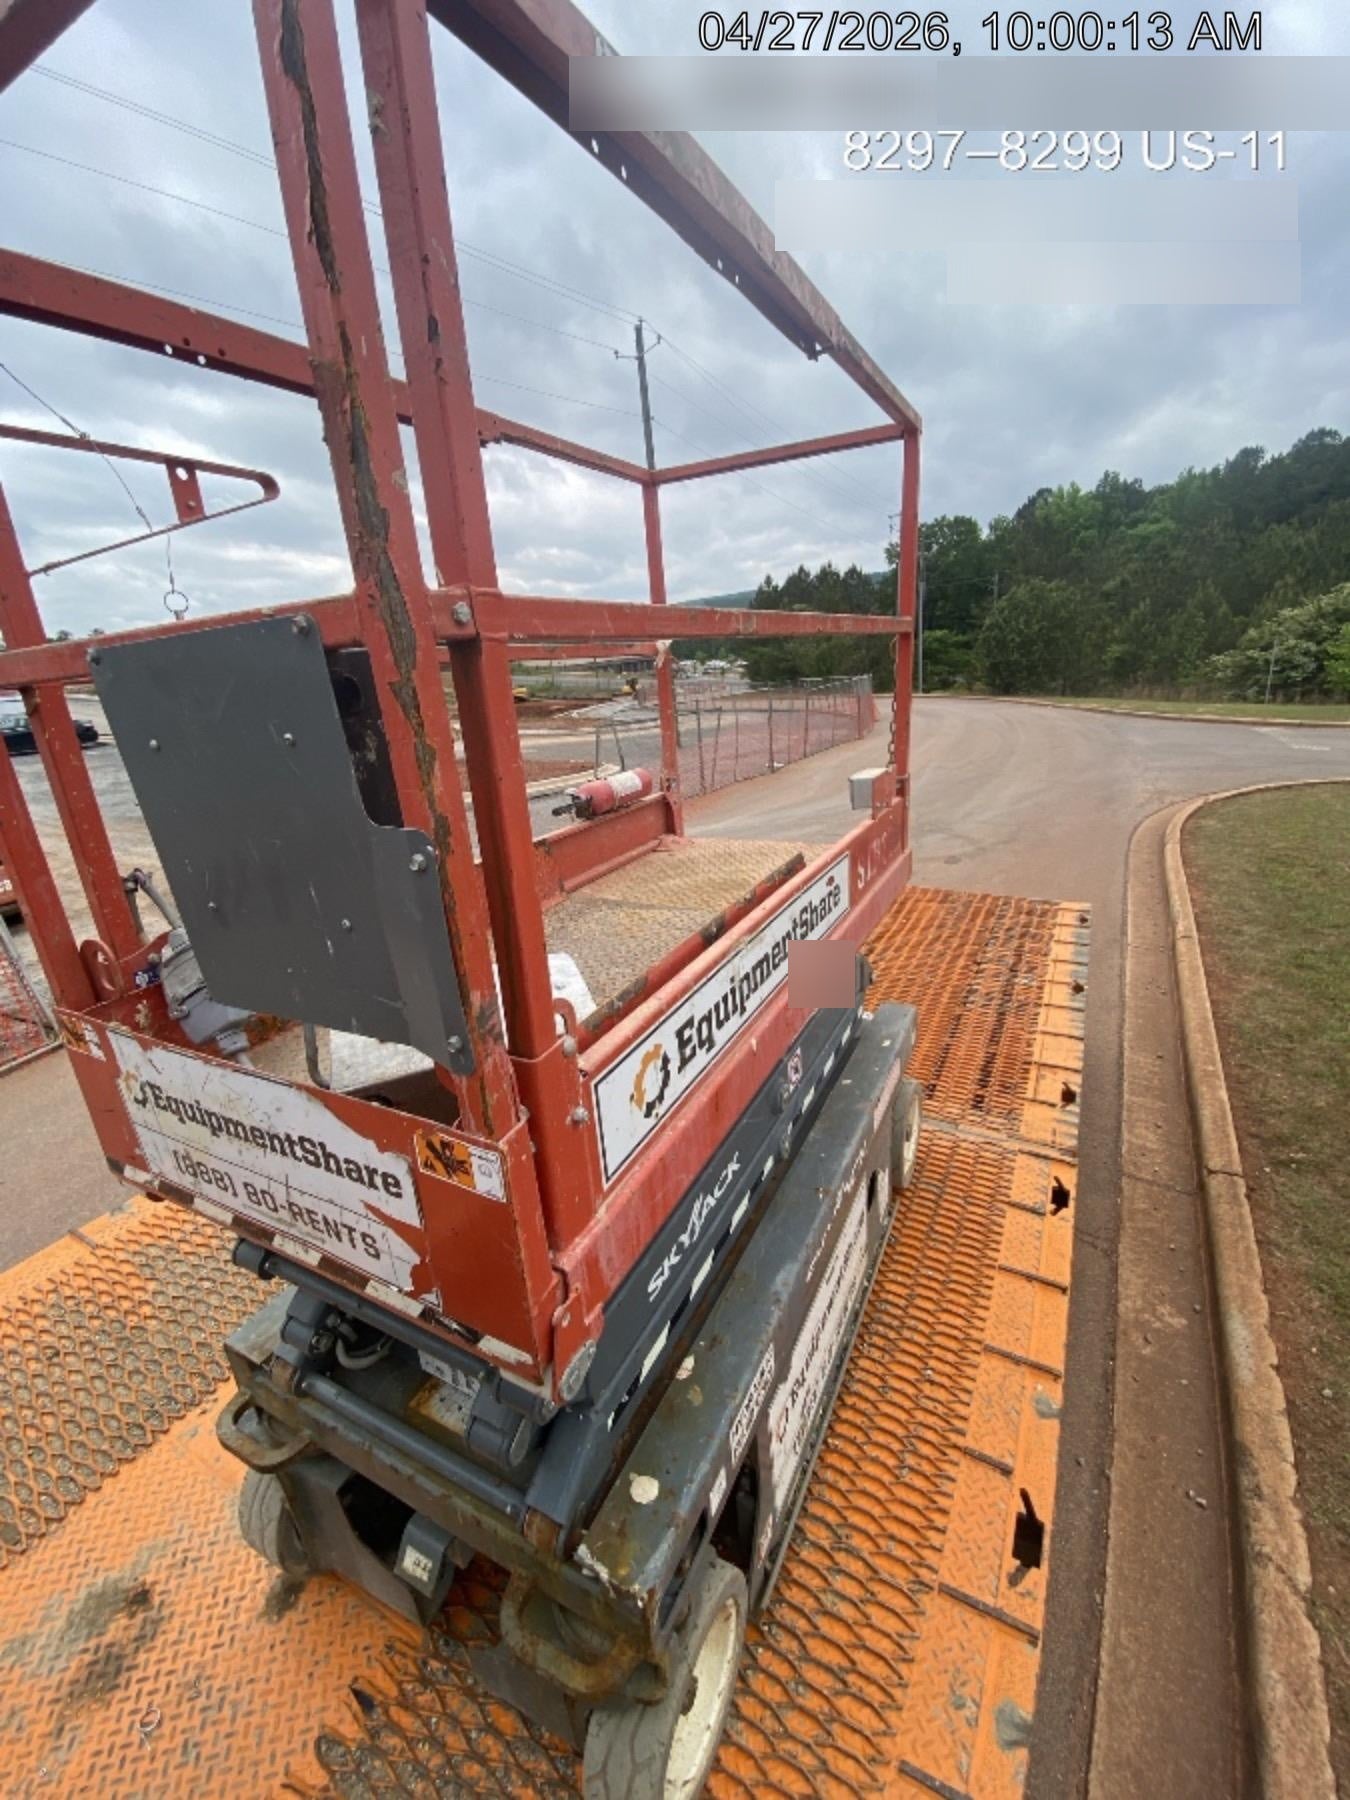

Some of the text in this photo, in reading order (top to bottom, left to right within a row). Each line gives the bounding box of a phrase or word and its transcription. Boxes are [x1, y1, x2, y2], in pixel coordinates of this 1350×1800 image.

[153, 1083, 404, 1199] EquipmentShare
[173, 1149, 239, 1198] (888)
[647, 1151, 741, 1303] SKYJACK
